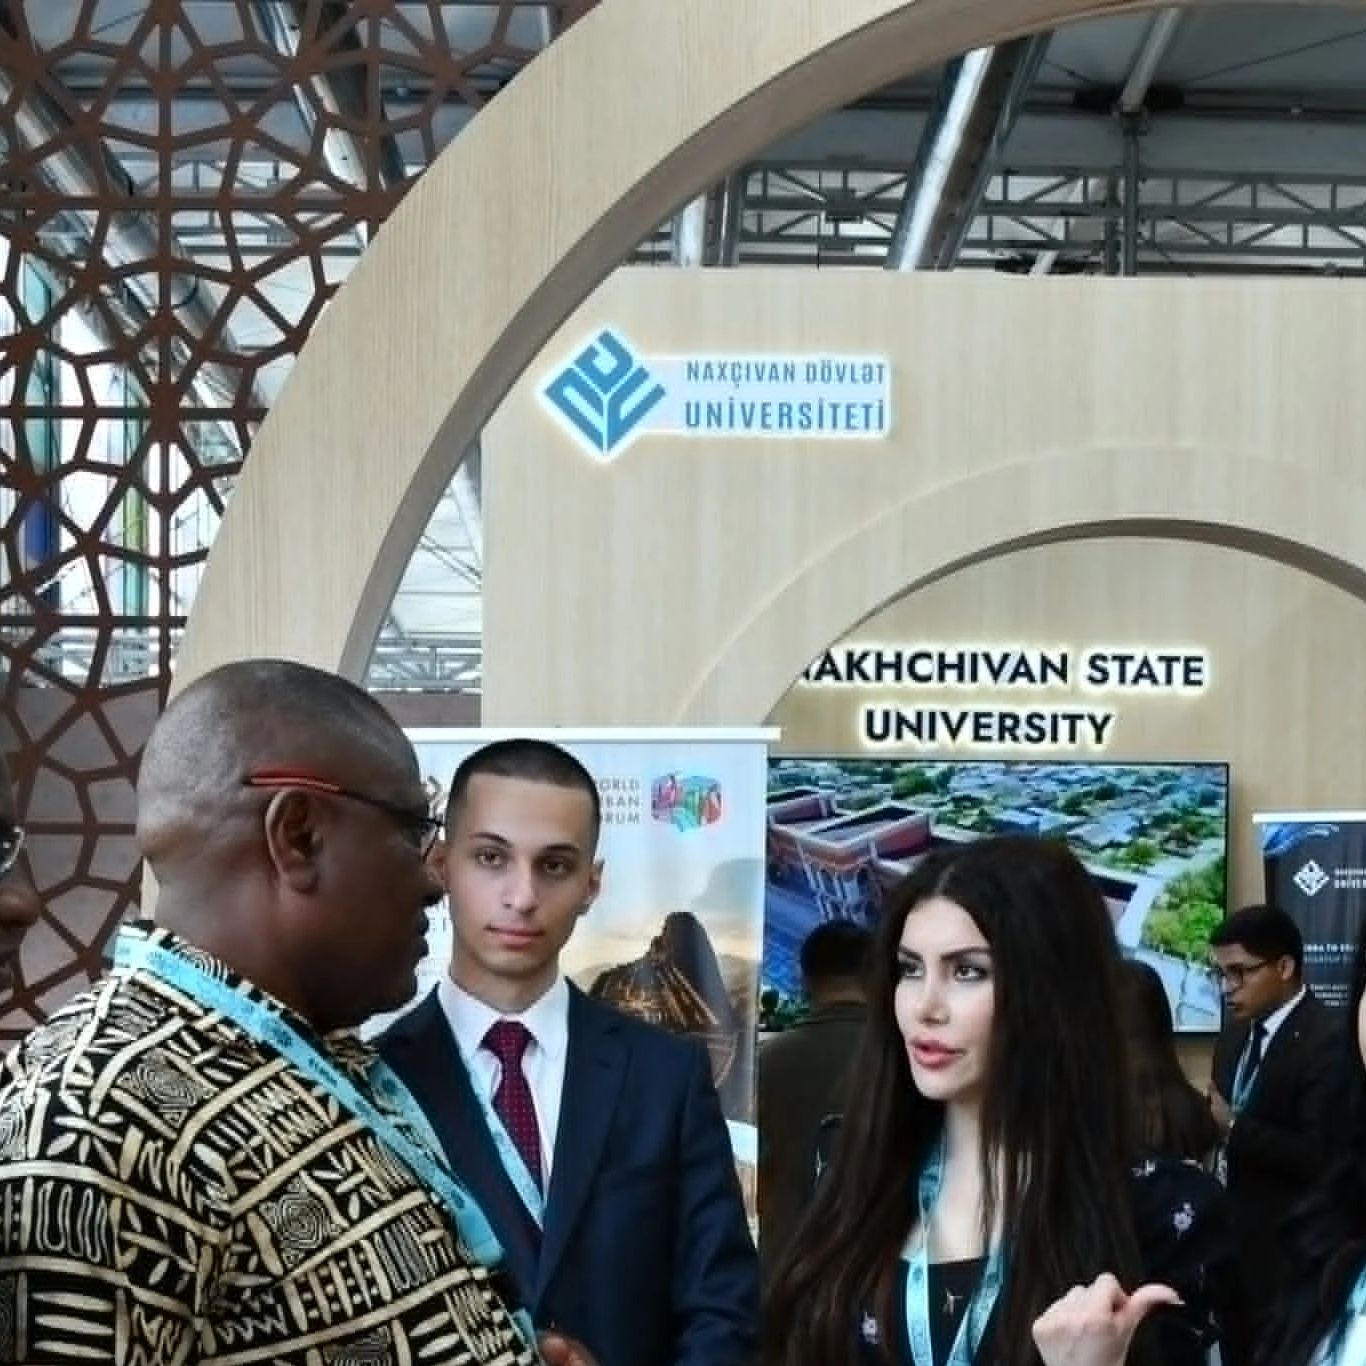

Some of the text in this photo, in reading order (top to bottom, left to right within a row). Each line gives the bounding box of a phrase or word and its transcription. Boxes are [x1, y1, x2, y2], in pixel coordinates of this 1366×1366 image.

[686, 358, 885, 387] NAXÇIVAN DÖVLƏT
[685, 395, 885, 431] UNİVERSİTETİ
[803, 650, 1205, 688] AKHCHIVAN STATE
[864, 710, 1113, 746] UNIVERSITY
